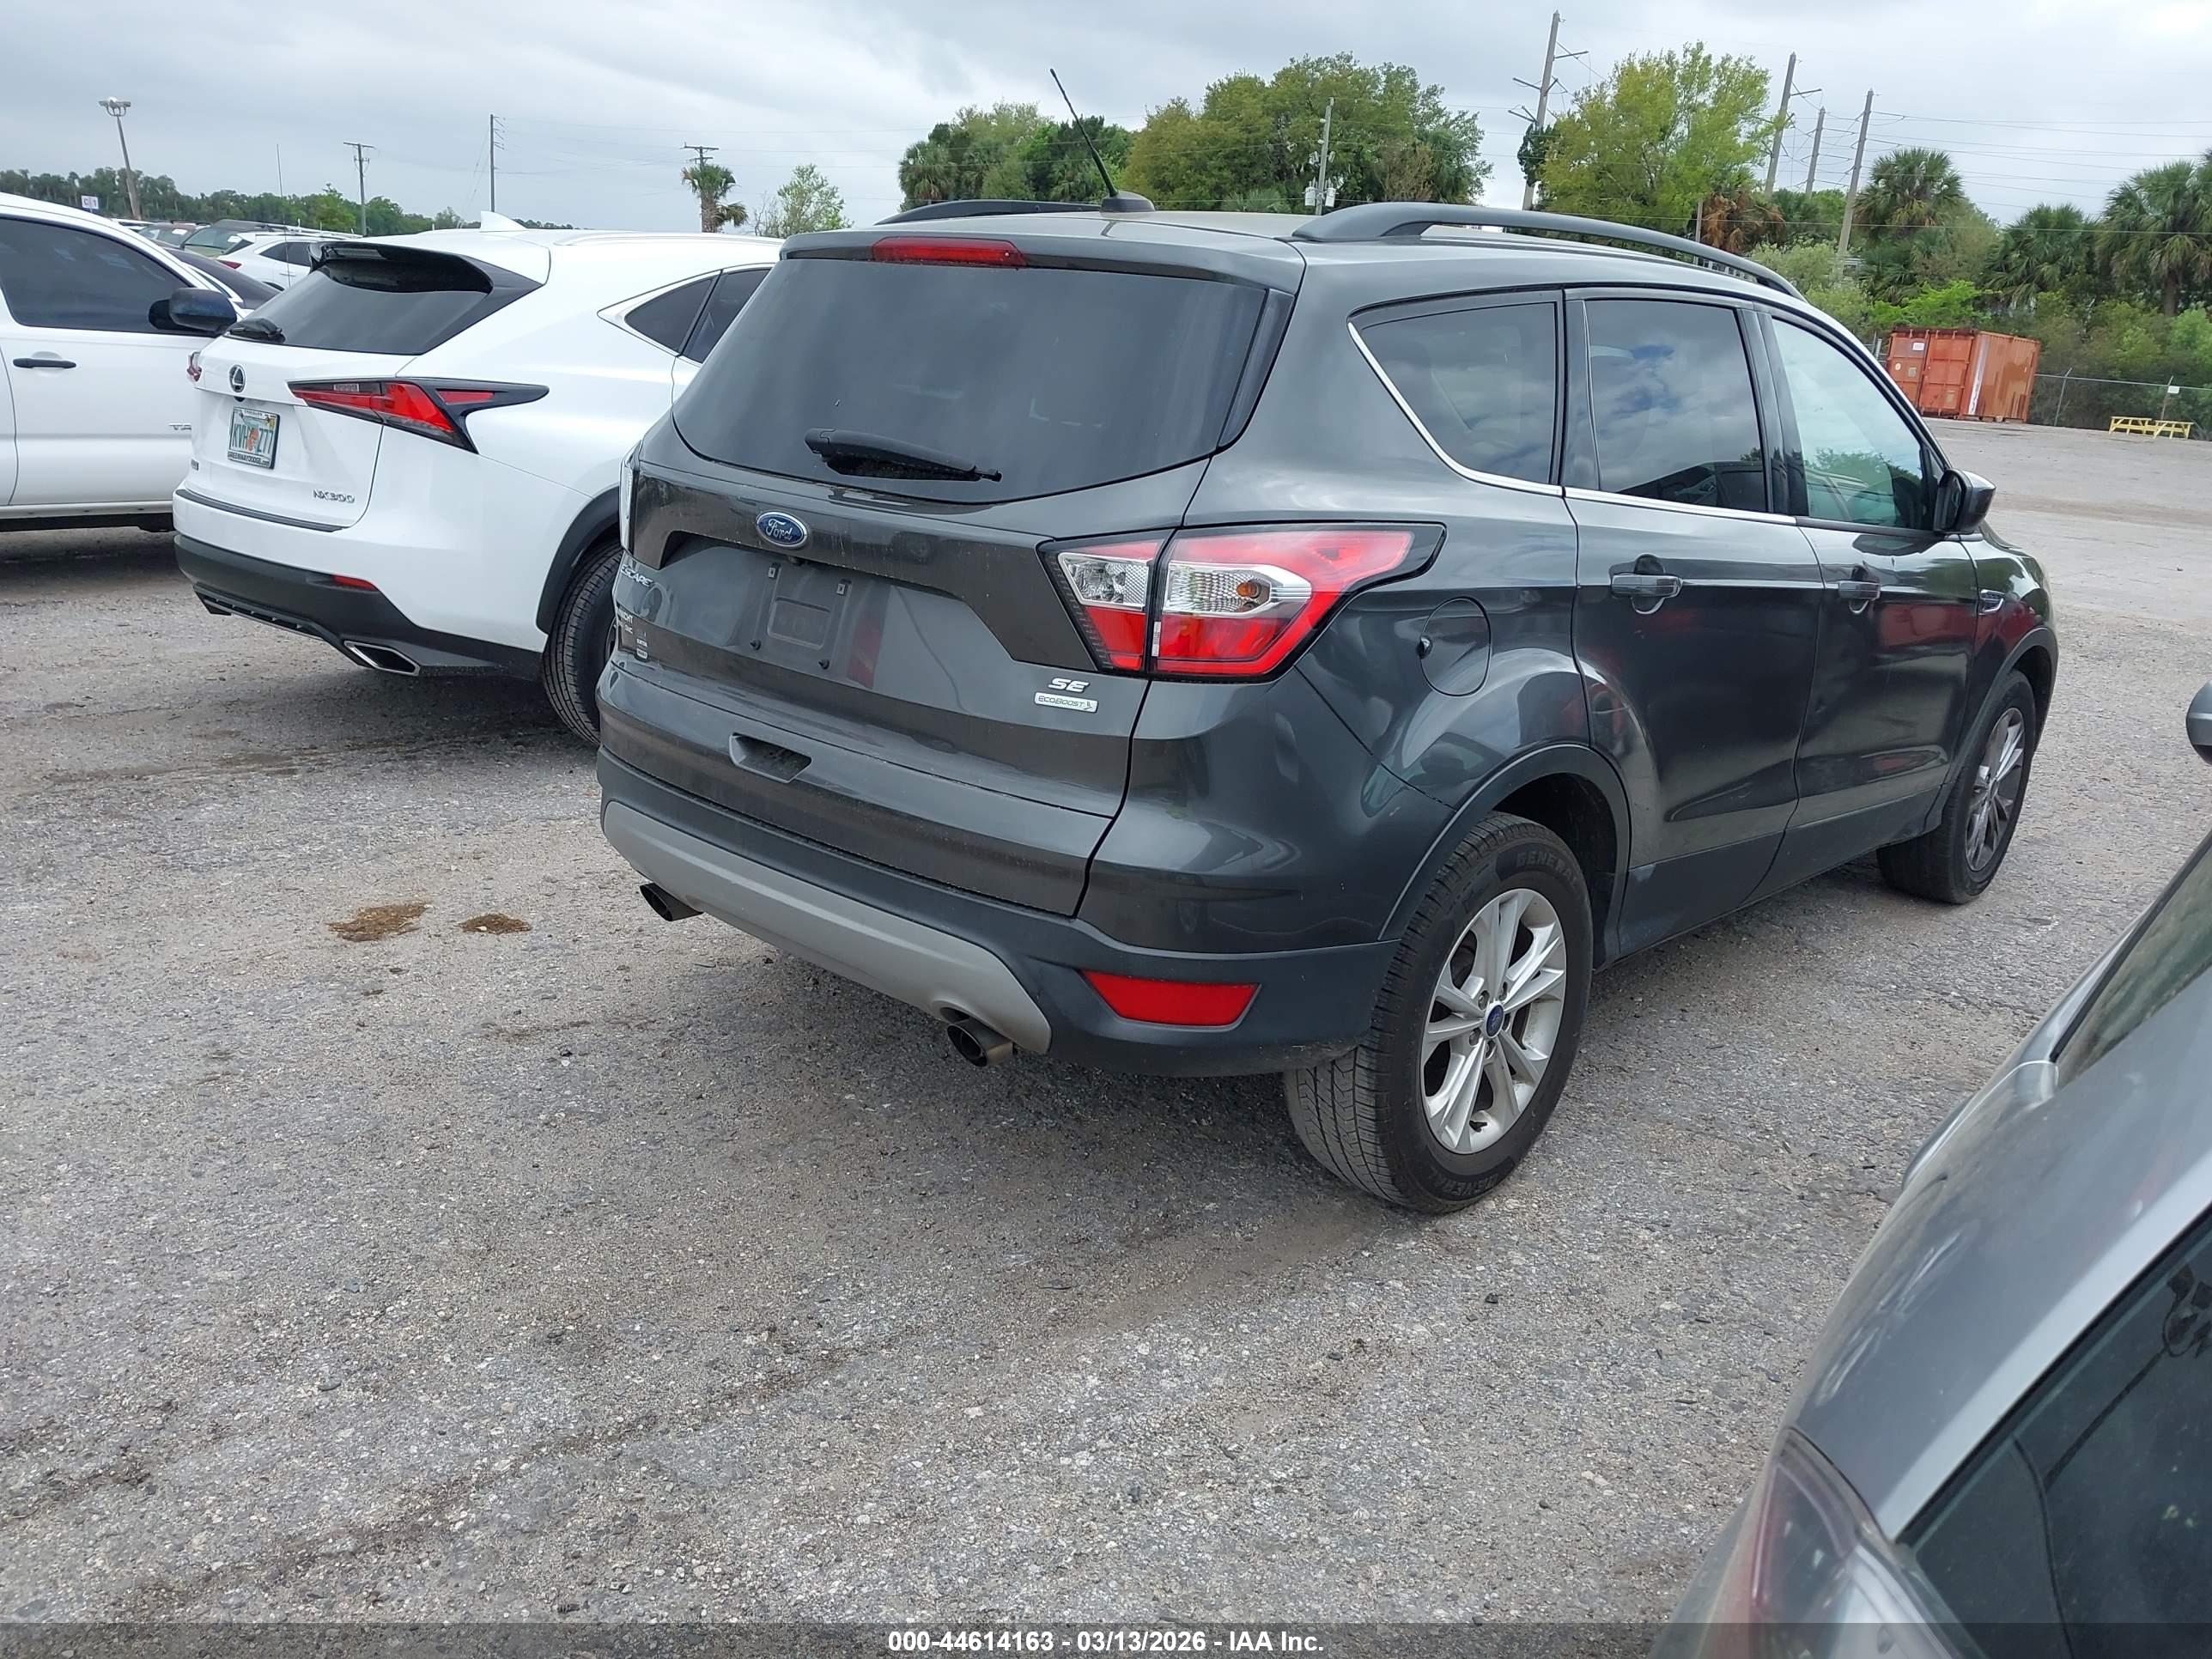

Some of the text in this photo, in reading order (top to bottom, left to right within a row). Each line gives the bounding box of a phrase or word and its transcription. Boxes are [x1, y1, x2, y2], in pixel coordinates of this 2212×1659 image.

[766, 518, 793, 540] Ford
[620, 564, 653, 586] ESCAPE
[1048, 677, 1091, 693] SE
